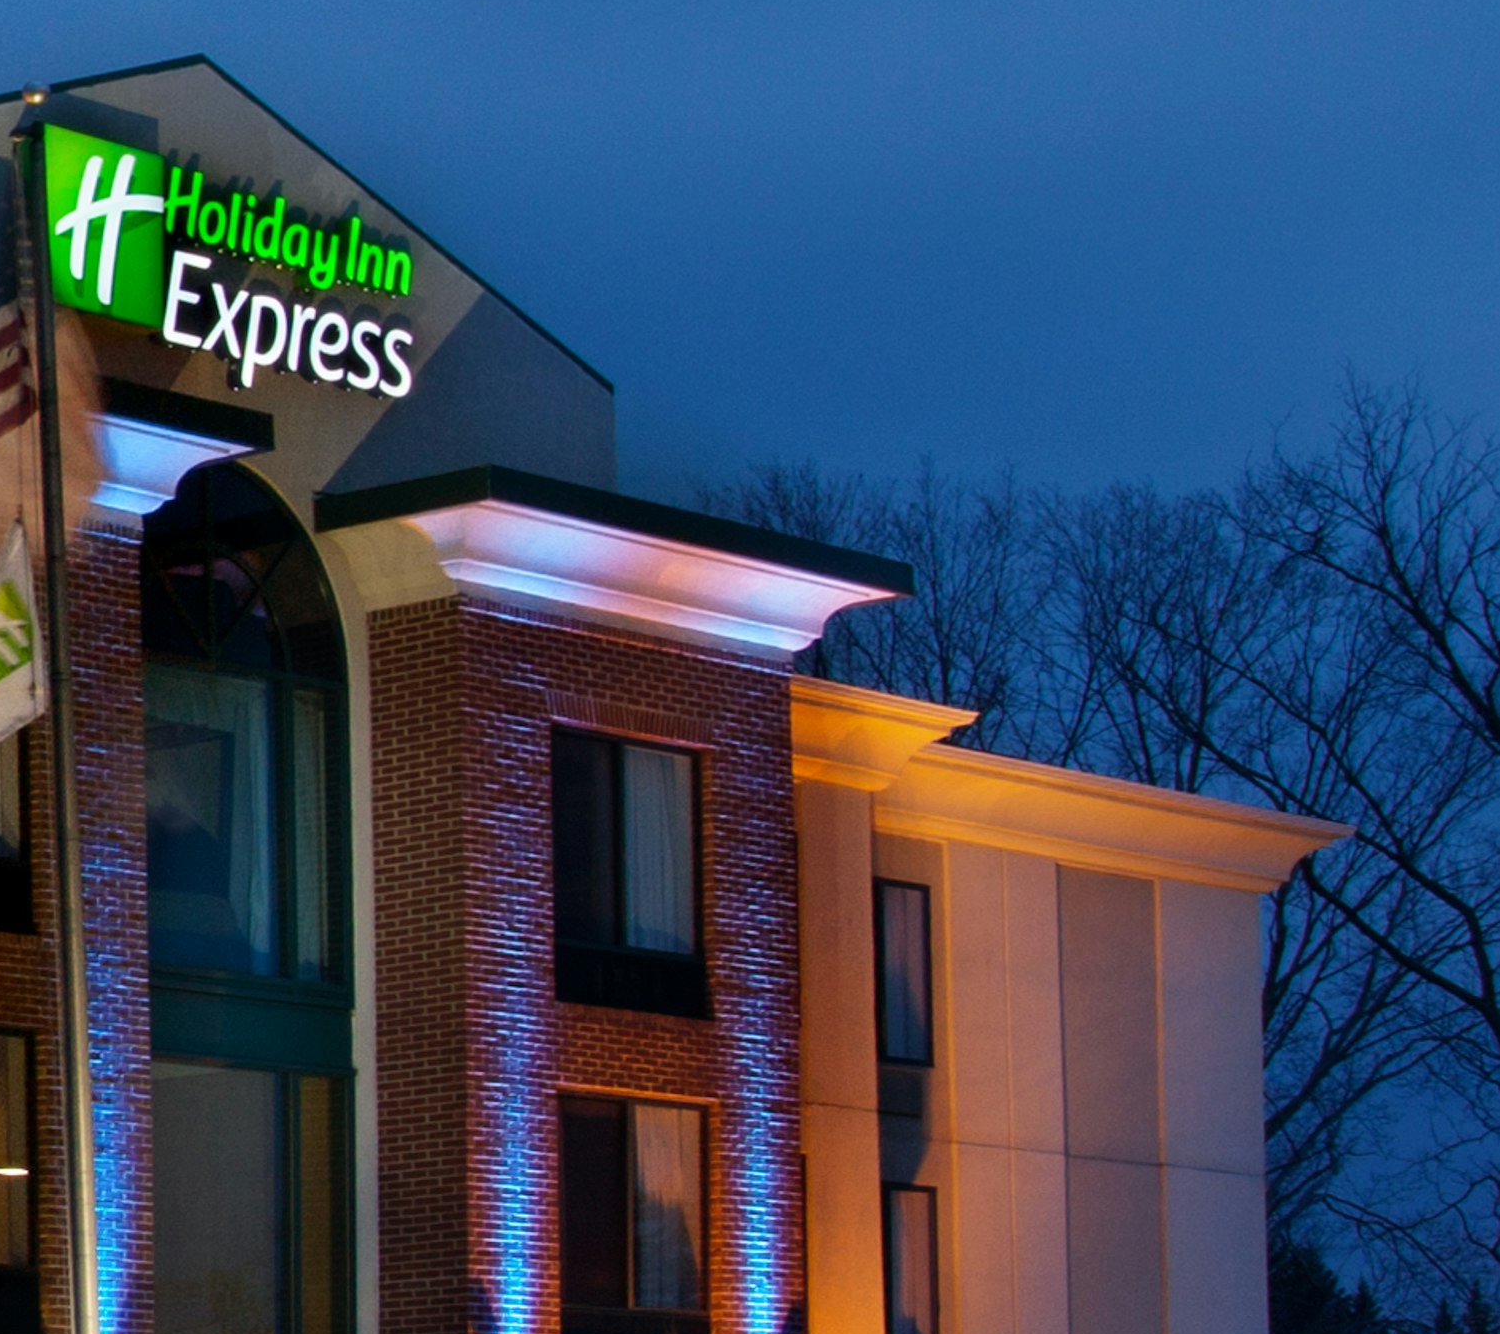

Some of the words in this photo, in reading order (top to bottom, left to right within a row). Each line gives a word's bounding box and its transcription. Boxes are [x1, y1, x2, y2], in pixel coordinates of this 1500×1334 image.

[164, 167, 340, 290] Holiday
[346, 216, 413, 296] Inn
[162, 250, 414, 399] Express
